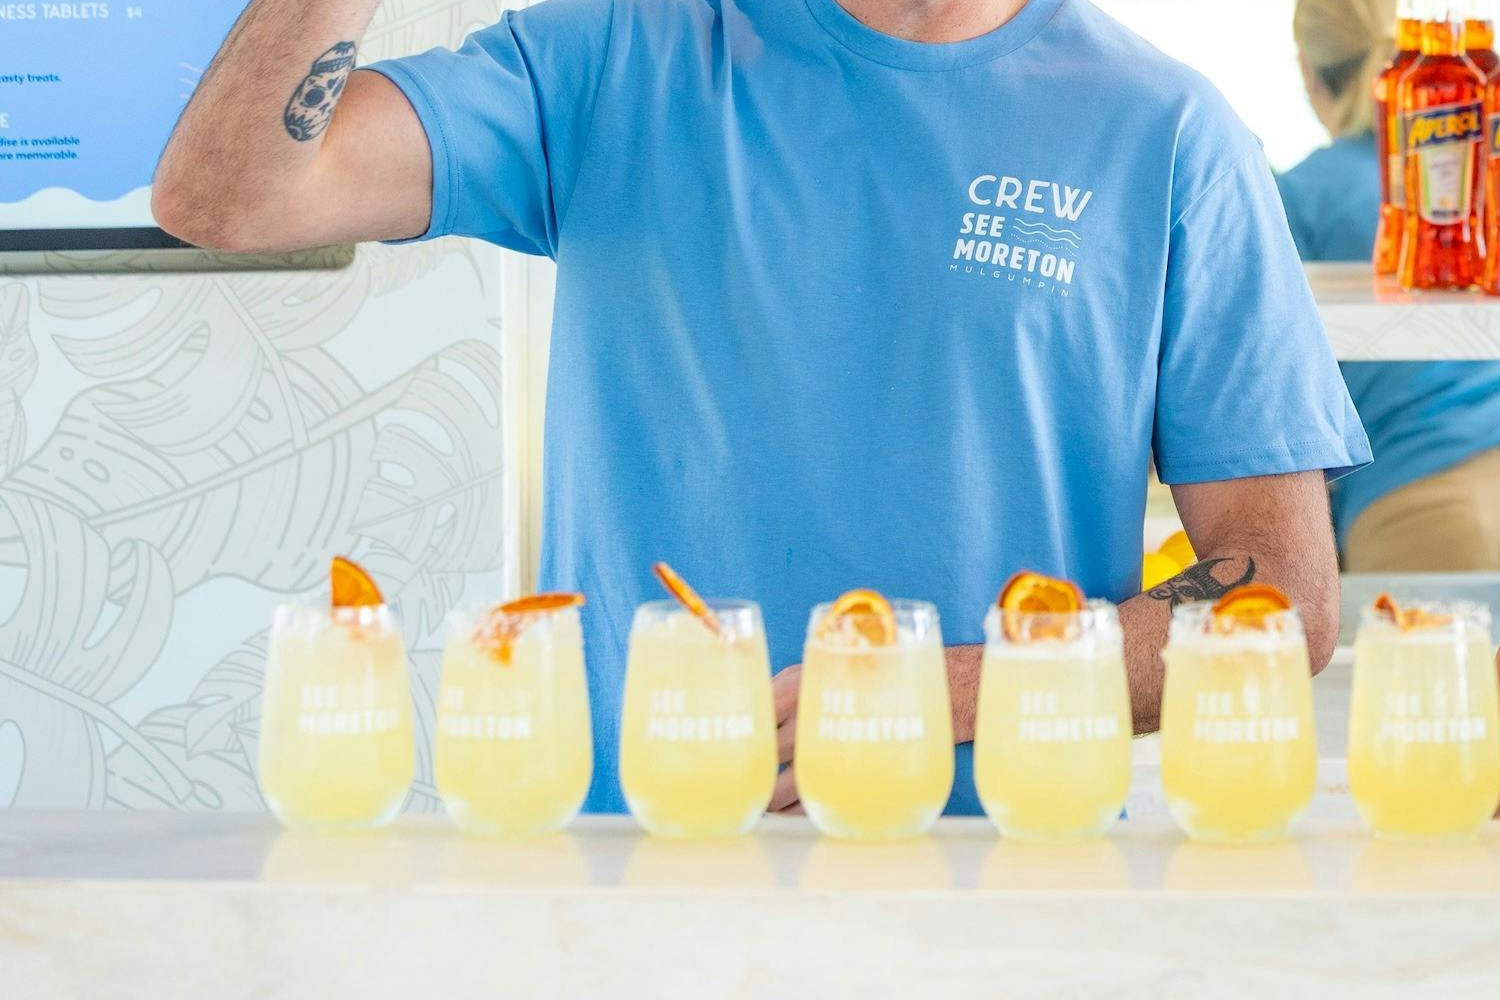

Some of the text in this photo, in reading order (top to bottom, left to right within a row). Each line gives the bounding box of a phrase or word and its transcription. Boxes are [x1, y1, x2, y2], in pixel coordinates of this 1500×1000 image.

[41, 3, 109, 19] TABLETS
[31, 135, 80, 147] available
[968, 174, 1094, 221] CREW
[959, 212, 1006, 238] SEE
[953, 238, 1075, 284] MORETON
[949, 264, 1069, 297] MULGUMPIN
[649, 715, 752, 741] MORETON
[820, 715, 924, 741] MORETON
[1194, 716, 1298, 743] MORETON
